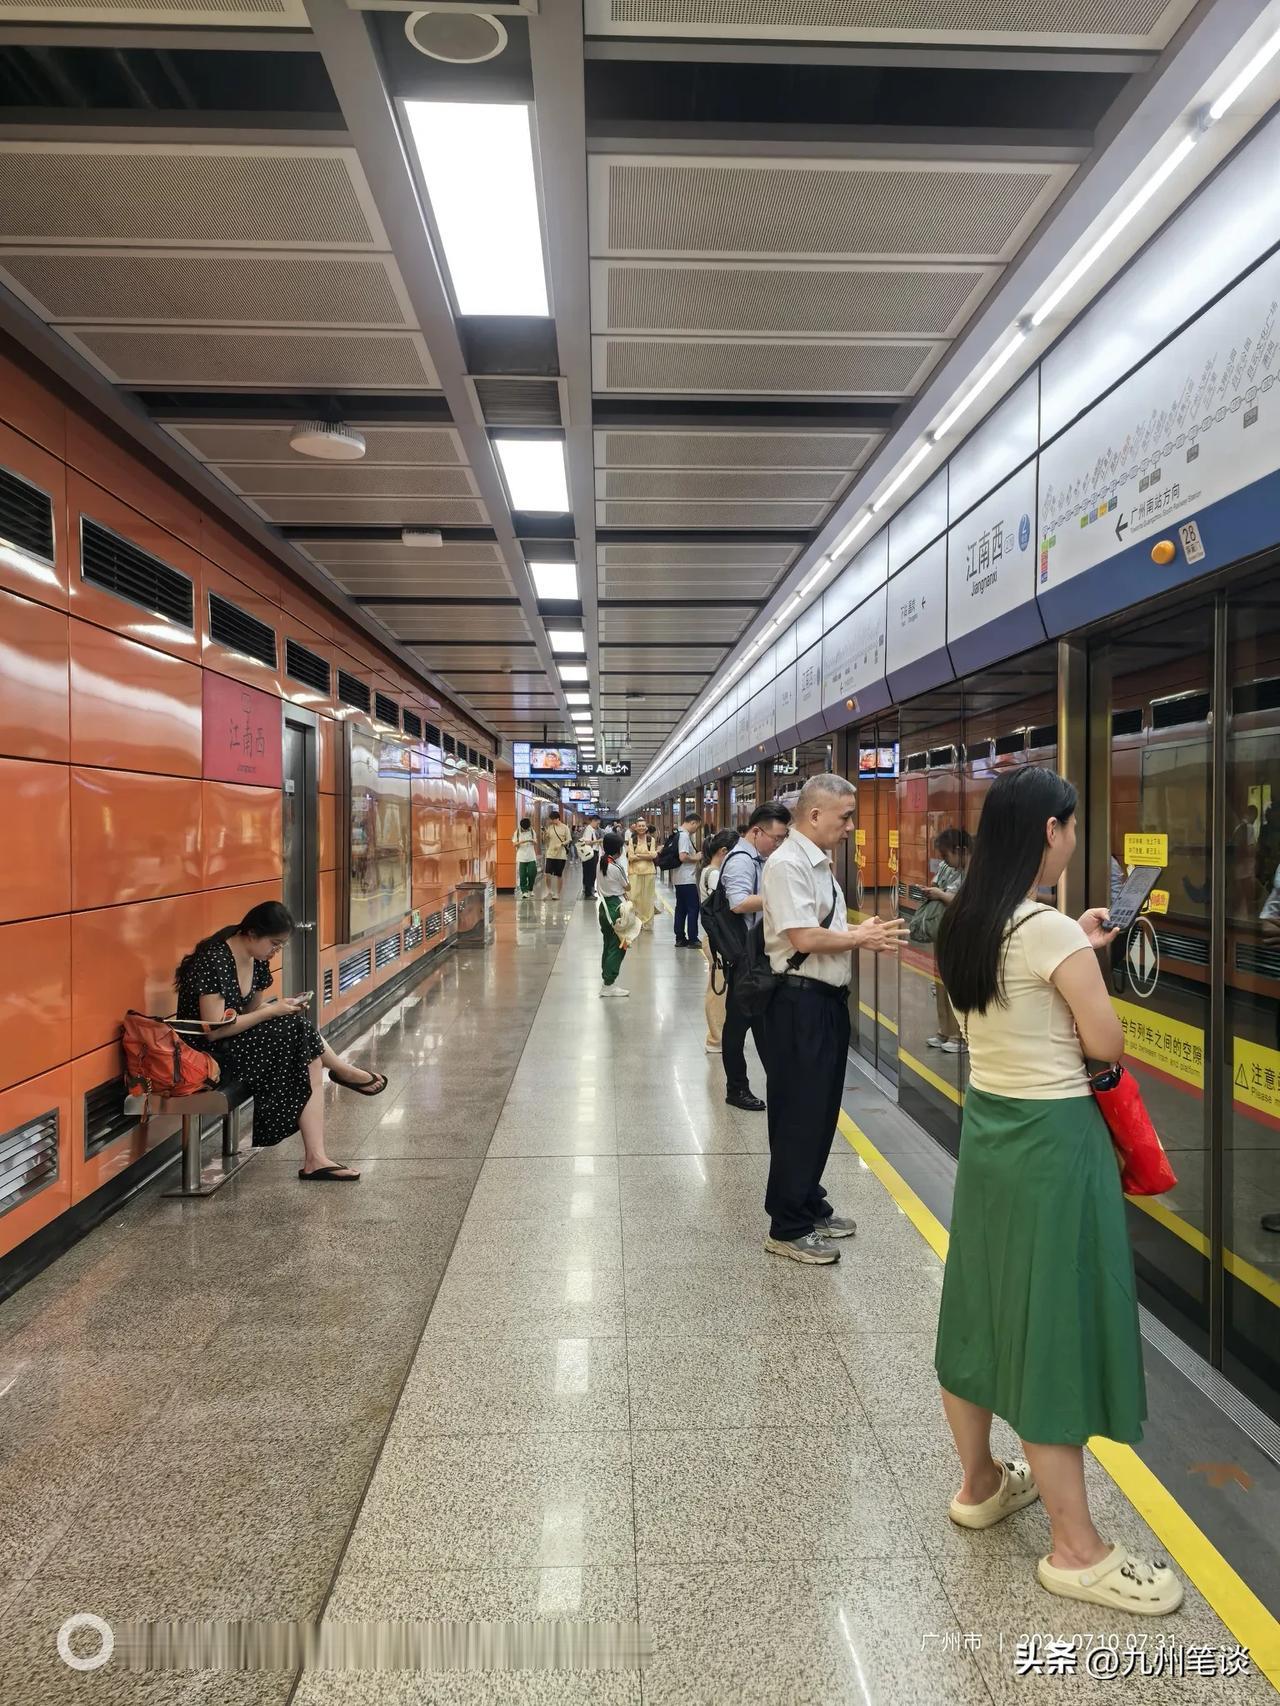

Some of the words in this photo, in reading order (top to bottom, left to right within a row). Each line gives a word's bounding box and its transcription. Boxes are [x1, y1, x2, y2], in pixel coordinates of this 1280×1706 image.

[1130, 483, 1180, 526] 广州南站方向
[966, 520, 1004, 582] 江南西
[1182, 525, 1197, 544] 28
[971, 566, 998, 597] Jiangnanxi
[229, 715, 265, 760] 江南西
[1118, 1014, 1202, 1066] 台与列车之间的空隙
[1251, 1062, 1280, 1091] 注意
[1251, 1086, 1273, 1104] Please
